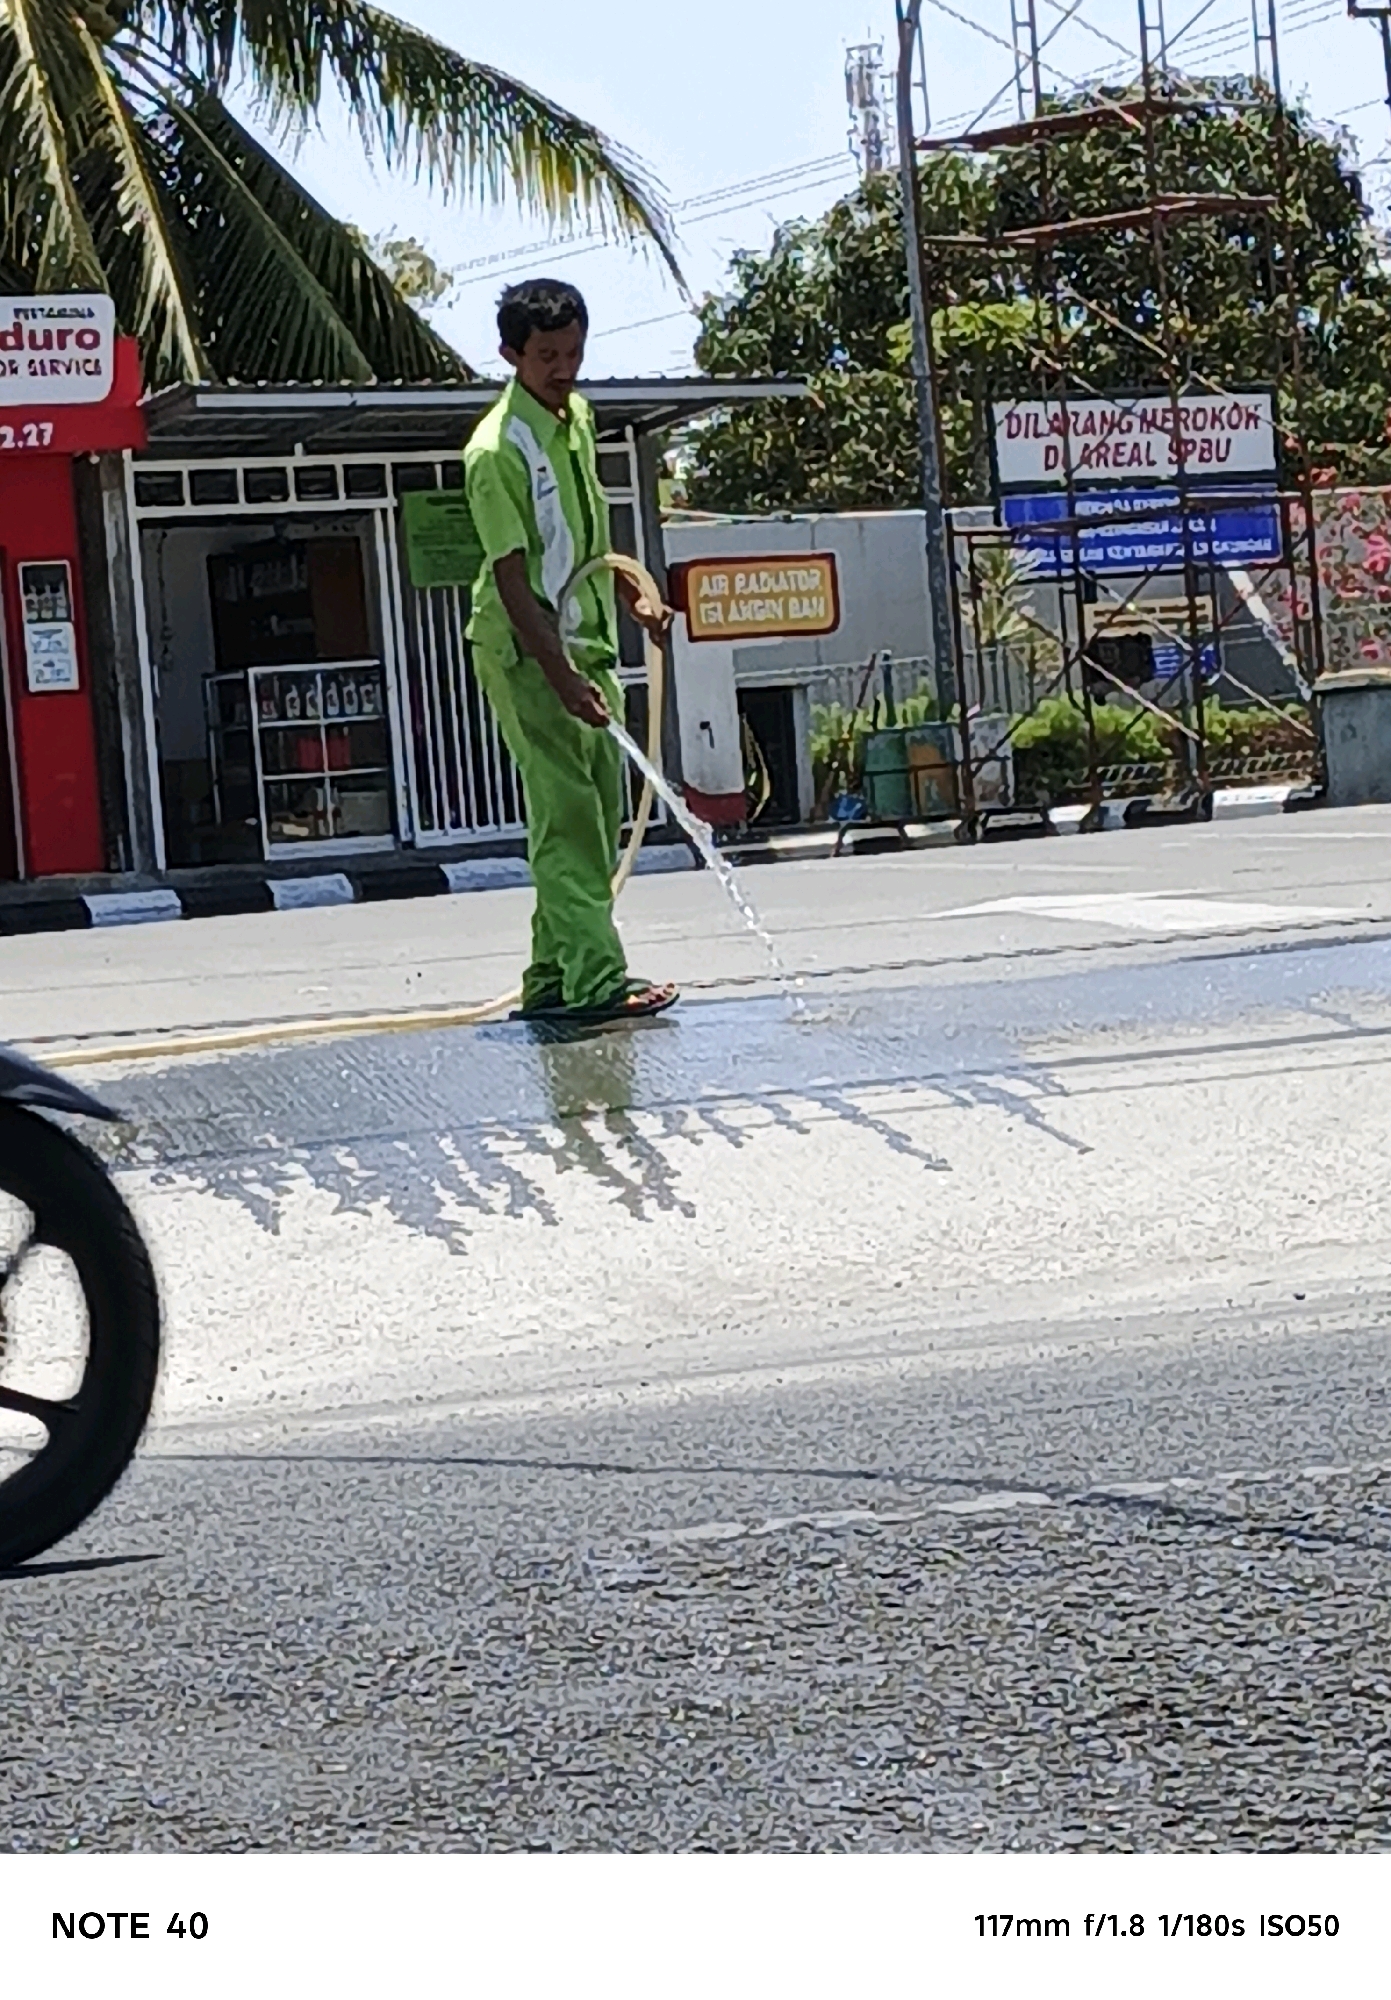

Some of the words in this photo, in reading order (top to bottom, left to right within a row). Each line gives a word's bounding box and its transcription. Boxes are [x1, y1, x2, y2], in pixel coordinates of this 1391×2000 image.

[0, 321, 101, 351] duro
[27, 358, 103, 377] SERVICE
[1005, 409, 1134, 439] DILARANG
[1080, 441, 1158, 469] AREAL
[1167, 437, 1232, 465] SPBU
[699, 573, 730, 598] AIR
[734, 568, 823, 596] RADIATOR
[788, 595, 826, 620] BAN
